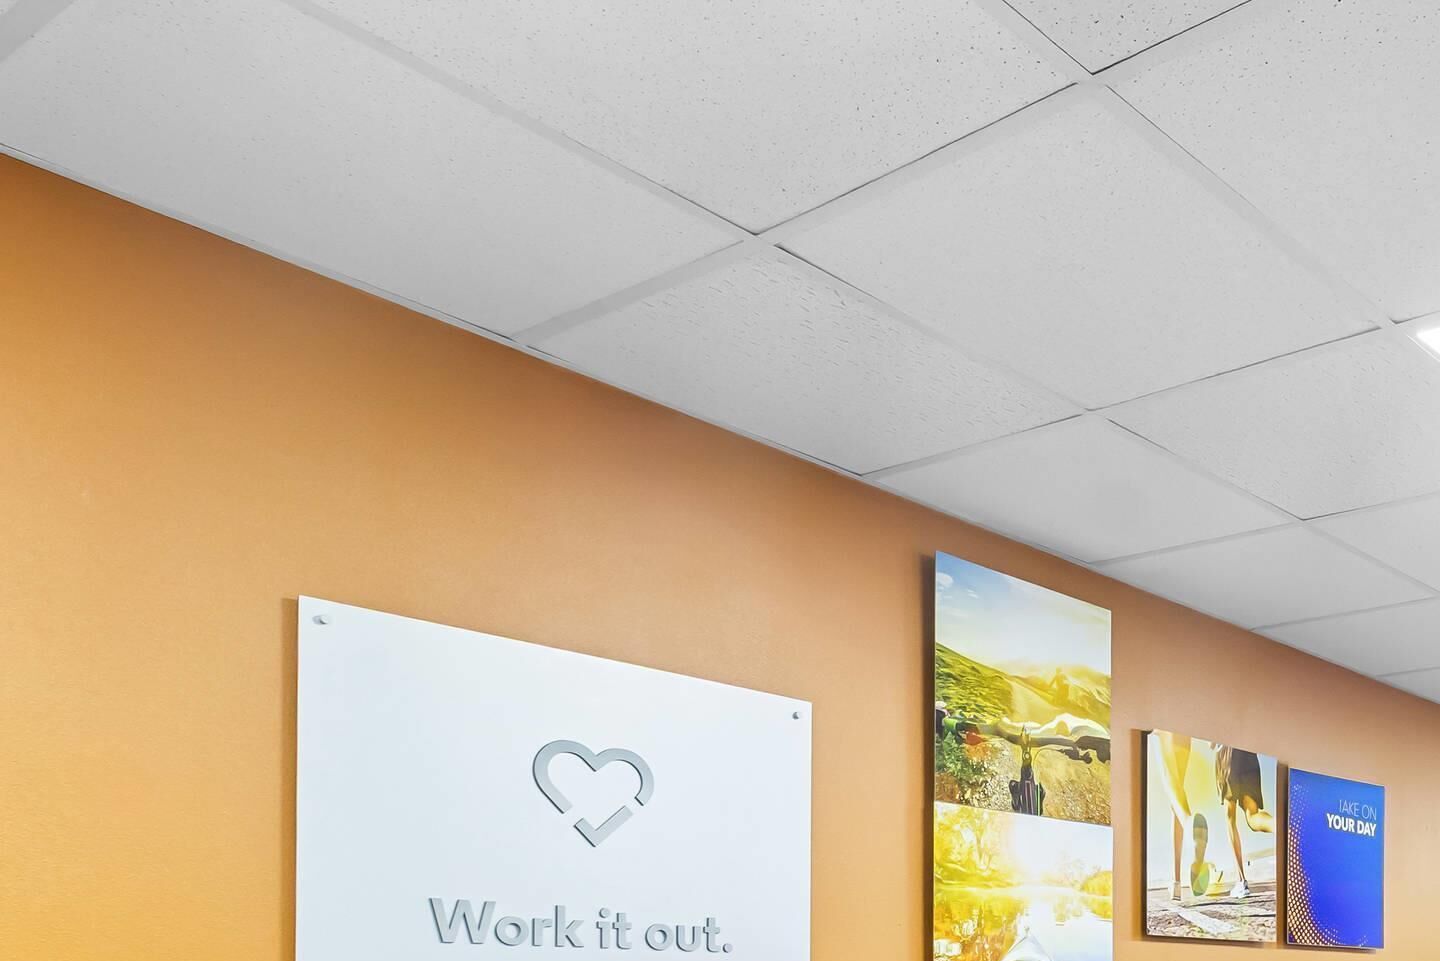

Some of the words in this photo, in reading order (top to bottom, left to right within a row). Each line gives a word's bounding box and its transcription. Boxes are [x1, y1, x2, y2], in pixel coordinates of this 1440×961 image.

[1338, 799, 1360, 817] TAKE
[1361, 804, 1377, 821] ON
[1326, 812, 1355, 832] YOUR
[1357, 820, 1377, 837] DAY
[428, 897, 585, 948] Work
[596, 907, 632, 950] it
[644, 917, 734, 953] out.
